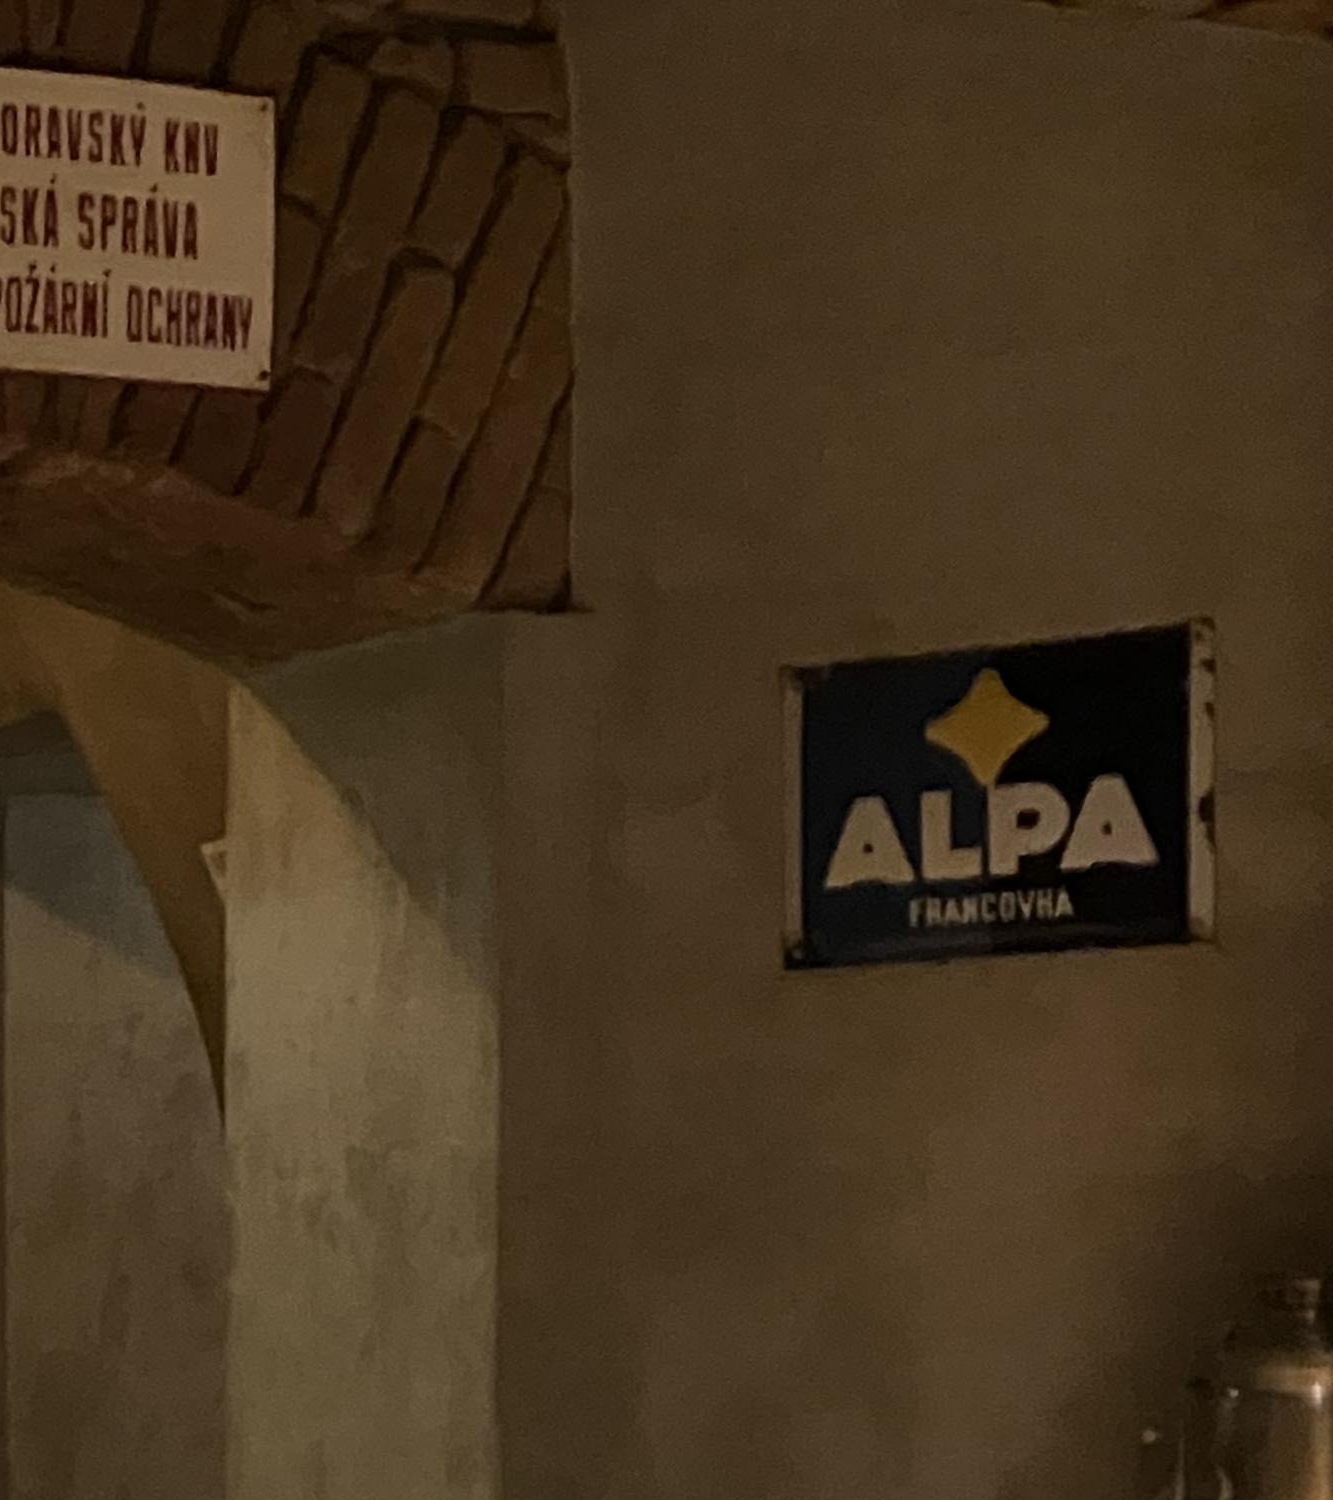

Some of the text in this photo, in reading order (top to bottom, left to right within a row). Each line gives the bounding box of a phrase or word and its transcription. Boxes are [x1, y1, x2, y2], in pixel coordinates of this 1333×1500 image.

[164, 116, 219, 176] KNV
[77, 183, 199, 260] SPRÁVA
[126, 284, 253, 352] OCHRANY
[824, 772, 1161, 889] ALPA
